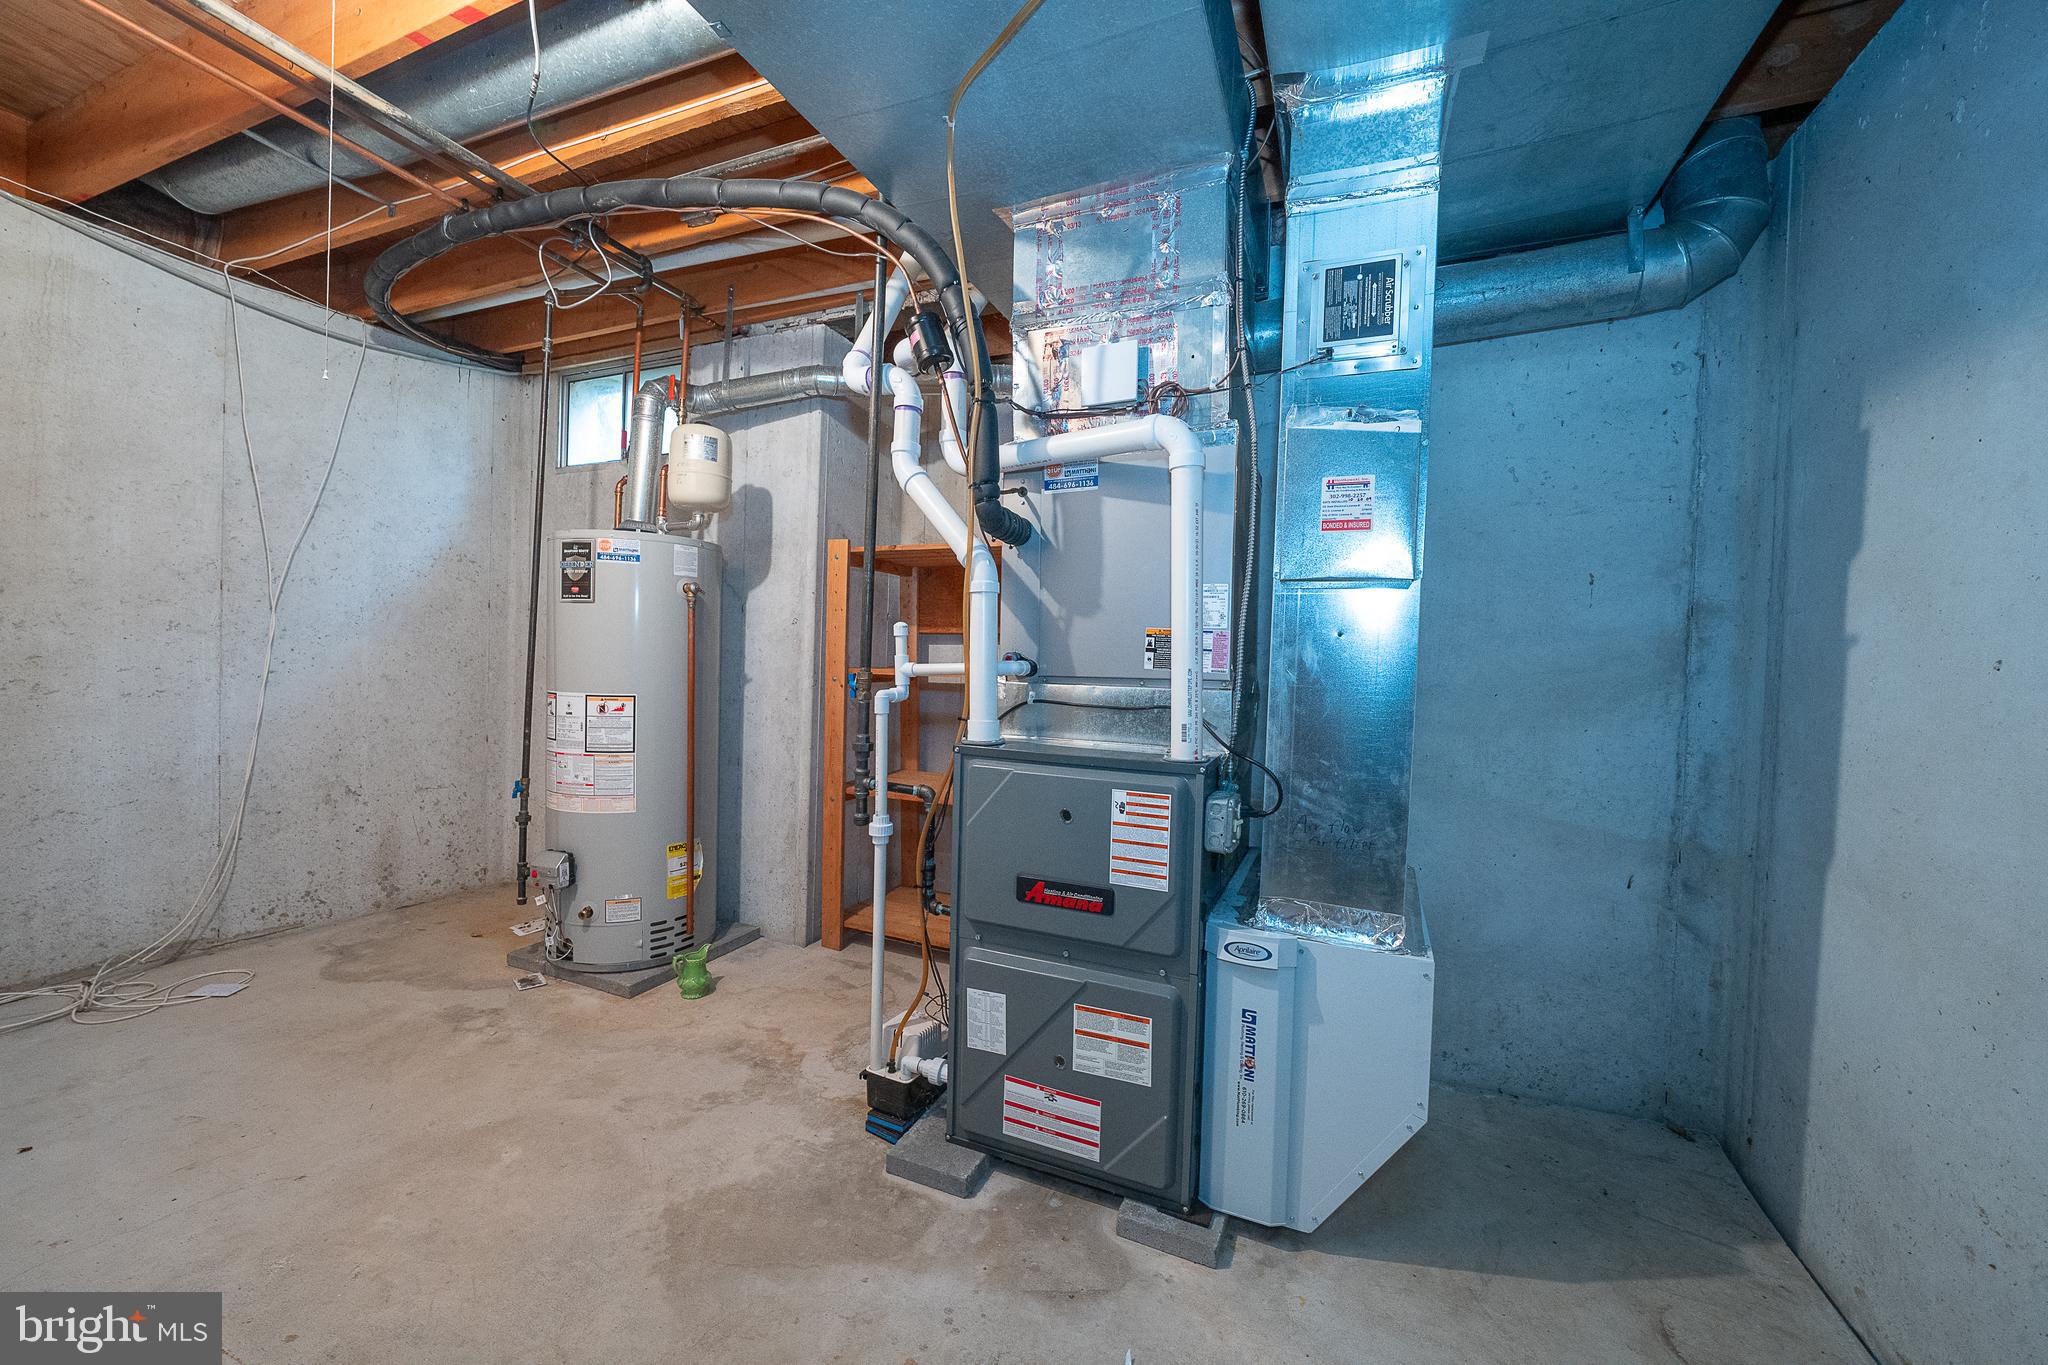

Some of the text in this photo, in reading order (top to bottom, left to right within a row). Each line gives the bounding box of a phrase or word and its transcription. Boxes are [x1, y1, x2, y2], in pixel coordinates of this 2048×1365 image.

[1384, 277, 1394, 325] Air Scrubber
[1048, 480, 1094, 490] 484-696-1136
[1322, 522, 1344, 530] BONDED
[560, 560, 594, 568] DEFENDER
[1024, 881, 1104, 913] Amana
[1234, 944, 1262, 954] Aprilaire
[1243, 1025, 1257, 1082] MATTIONI
